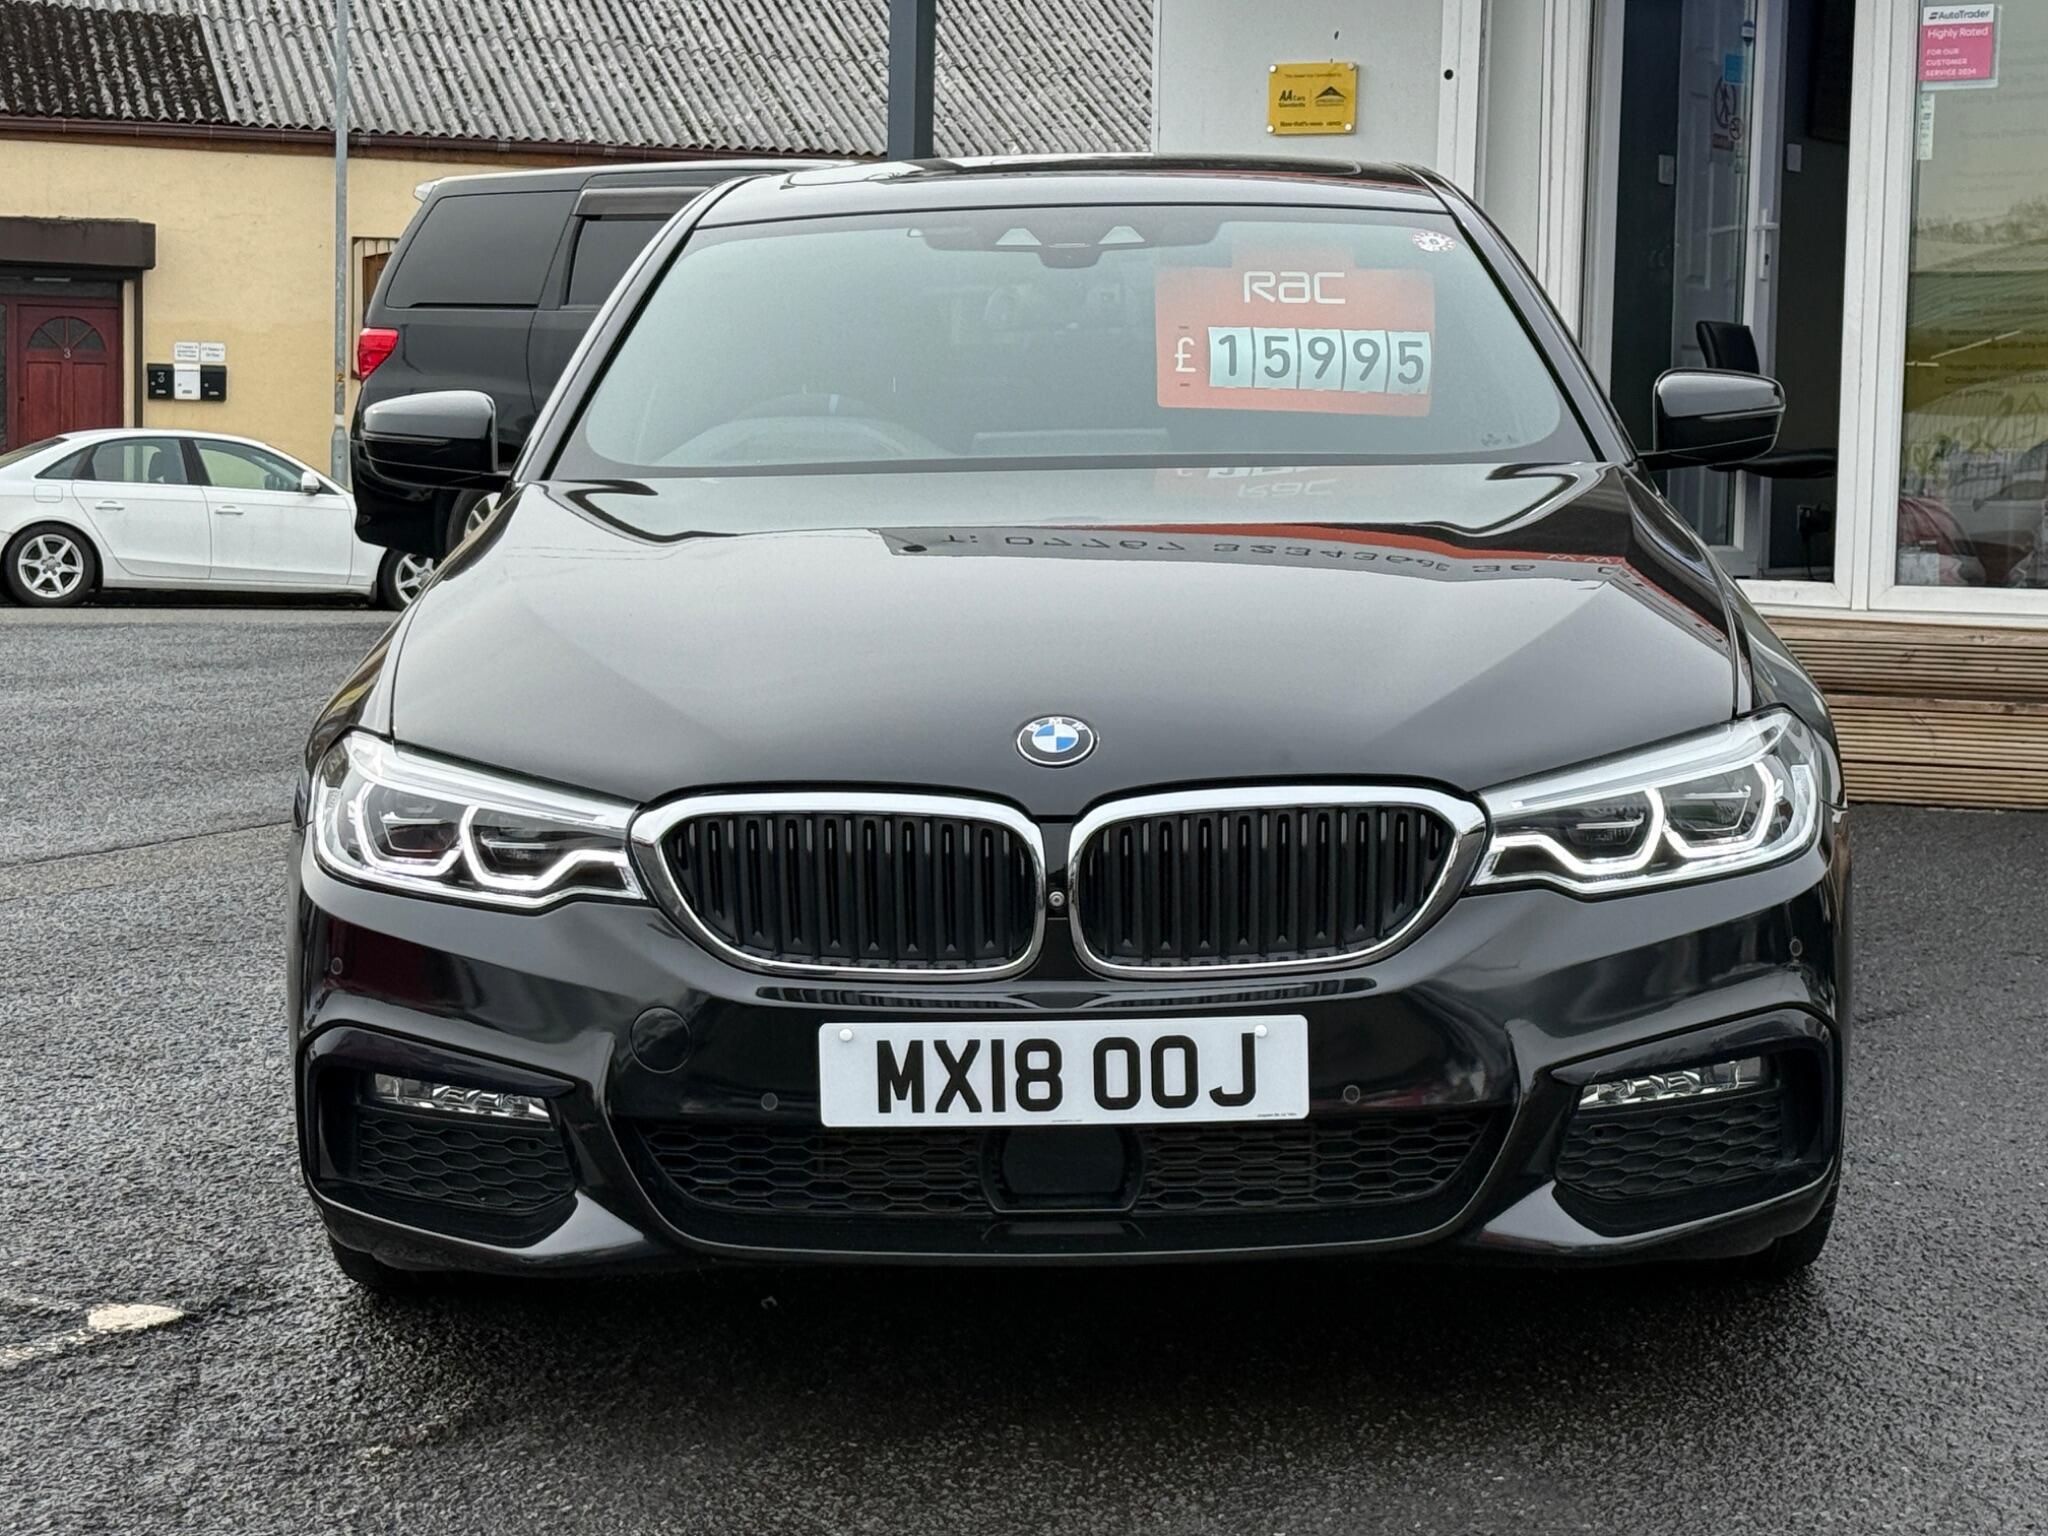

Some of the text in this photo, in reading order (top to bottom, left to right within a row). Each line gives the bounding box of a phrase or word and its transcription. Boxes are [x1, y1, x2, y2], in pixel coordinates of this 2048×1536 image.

[1938, 9, 1990, 20] AutoTrader
[1928, 27, 1989, 39] Highly Rated
[1925, 58, 1968, 66] CUSTOMER
[1279, 89, 1293, 101] AA
[64, 348, 71, 359] 3
[876, 1032, 1257, 1114] MX18 OOJ
